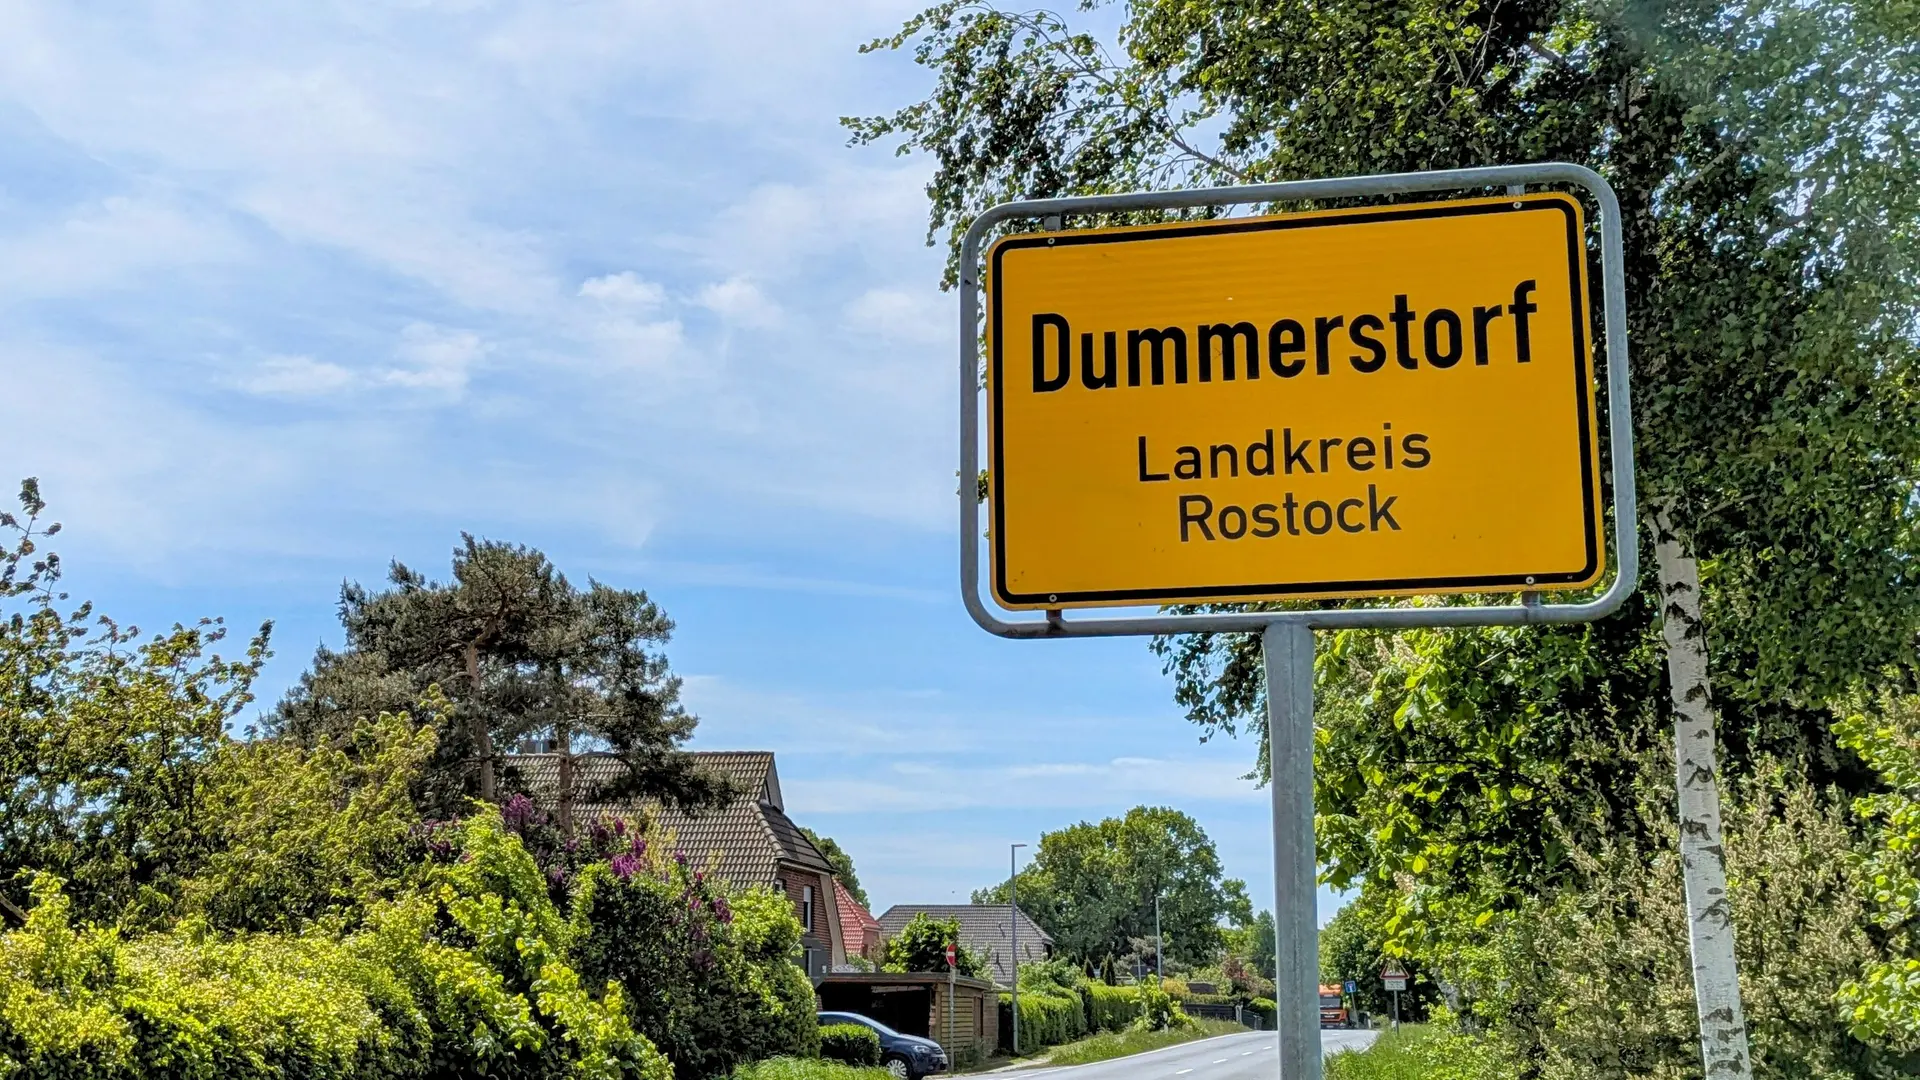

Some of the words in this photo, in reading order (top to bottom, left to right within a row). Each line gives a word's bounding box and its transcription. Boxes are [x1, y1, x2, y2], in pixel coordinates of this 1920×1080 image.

[1031, 280, 1538, 393] Dummerstorf
[1138, 423, 1431, 482] Landkreis
[1179, 484, 1401, 542] Rostock
